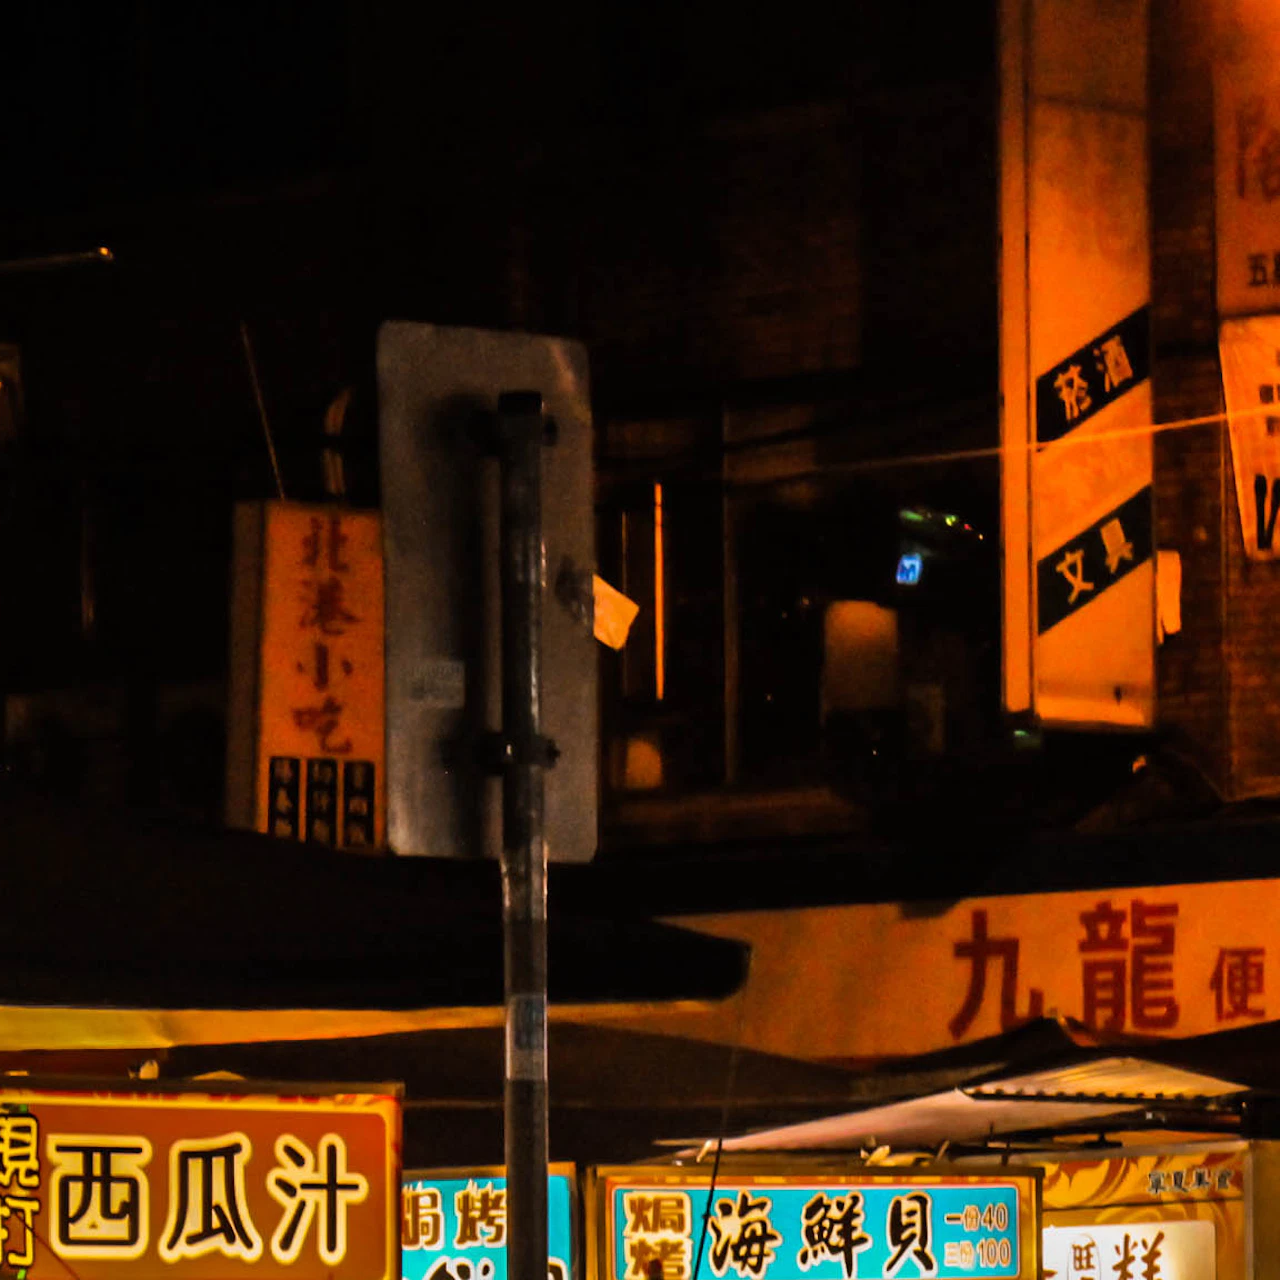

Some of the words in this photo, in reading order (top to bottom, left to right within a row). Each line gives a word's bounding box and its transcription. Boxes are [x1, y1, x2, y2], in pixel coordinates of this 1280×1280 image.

[948, 898, 1181, 1042] 九龍
[52, 1140, 363, 1256] 西瓜汁
[710, 1192, 934, 1278] 海鮮貝
